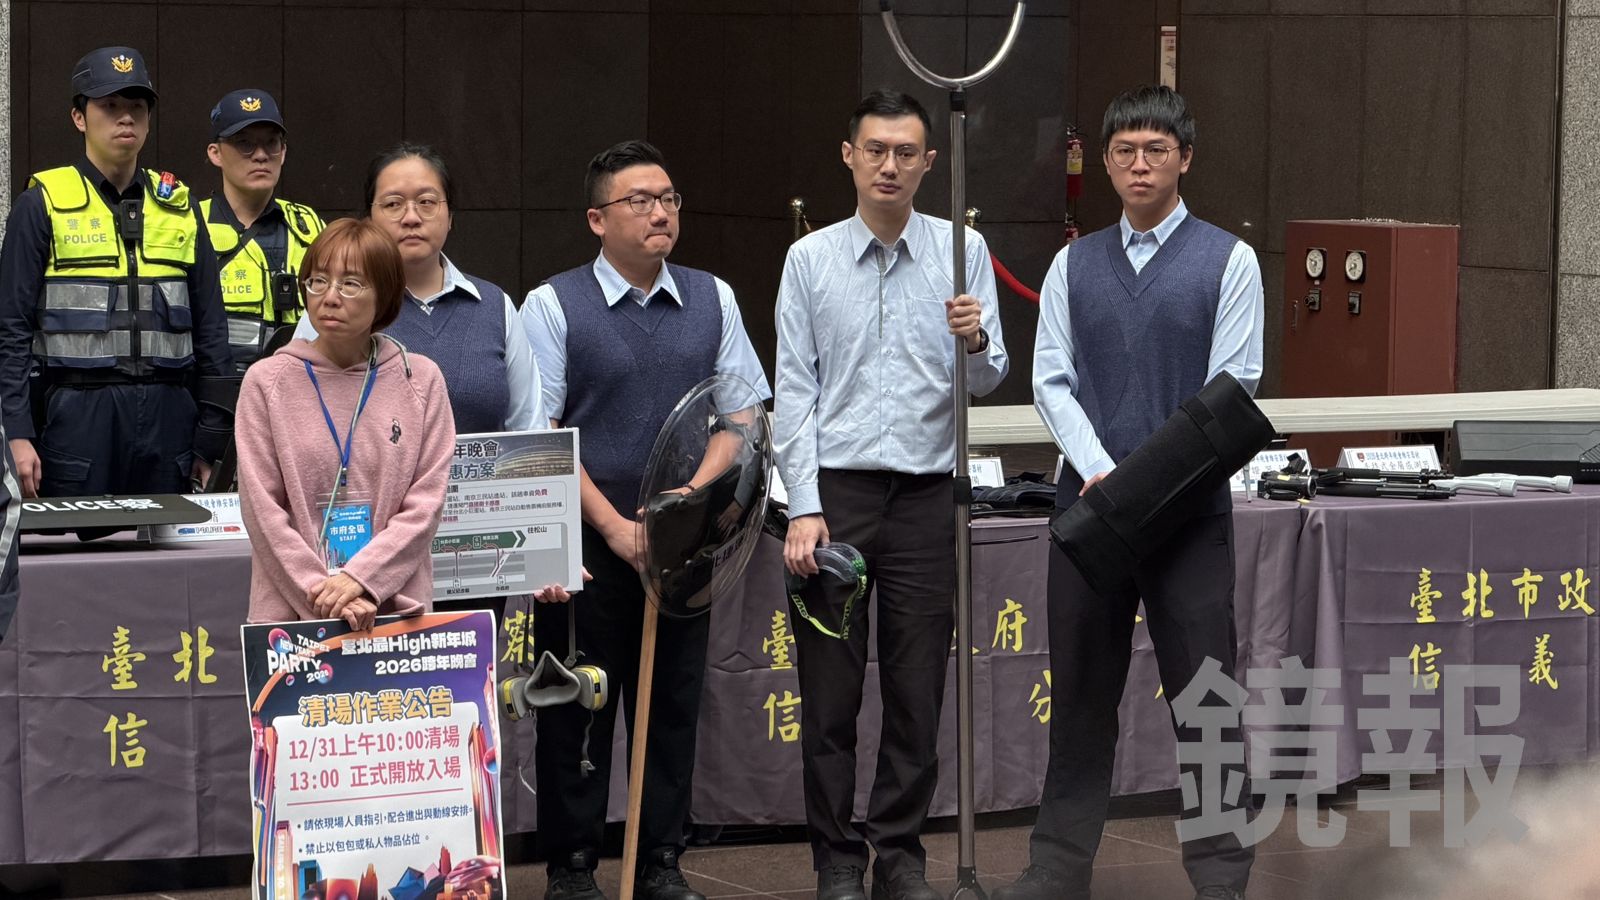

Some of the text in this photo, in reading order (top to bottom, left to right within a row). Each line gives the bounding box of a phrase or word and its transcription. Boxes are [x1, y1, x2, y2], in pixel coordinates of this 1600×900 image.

[66, 218, 101, 230] 警察
[63, 233, 107, 244] POLICE
[221, 285, 252, 294] OLICE
[453, 440, 498, 459] 年晚會
[448, 462, 496, 480] 惠方案
[22, 500, 122, 512] OLICE
[991, 598, 1028, 652] 府
[297, 633, 330, 653] TAIPEI
[762, 610, 796, 670] 臺
[267, 649, 322, 675] PARTY
[375, 653, 477, 675] 2026跨年晚會
[299, 685, 453, 728] 清場作業公告
[762, 690, 802, 743] 信
[103, 712, 148, 768] 信
[289, 725, 460, 762] 12/31上午10:00清場
[290, 756, 461, 791] 13:00 正式開放入場
